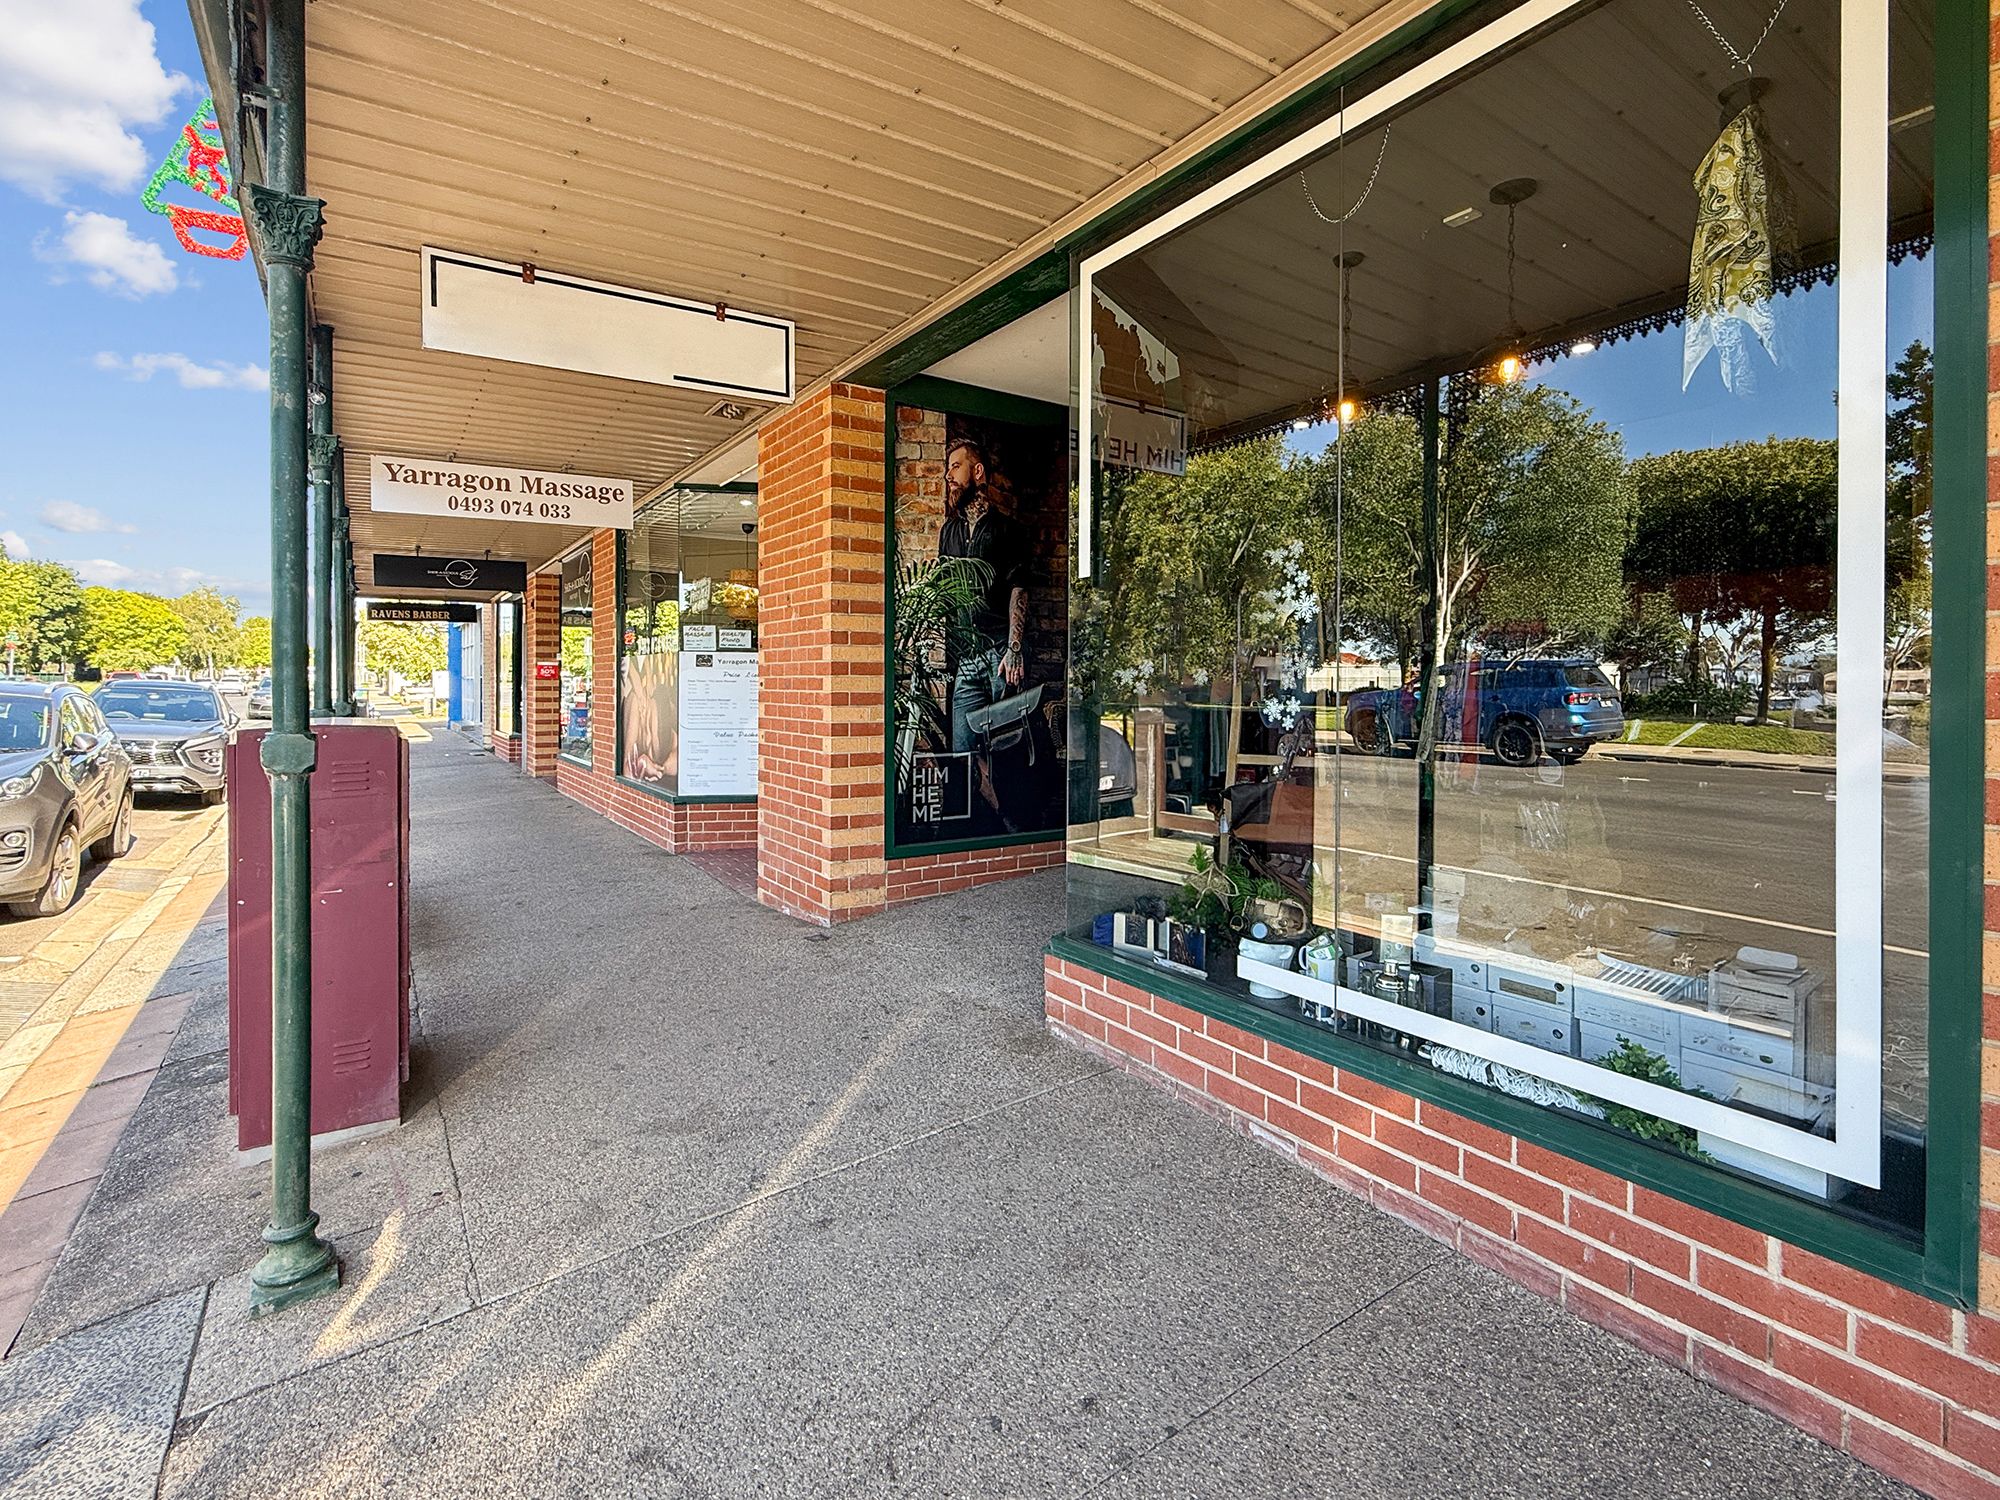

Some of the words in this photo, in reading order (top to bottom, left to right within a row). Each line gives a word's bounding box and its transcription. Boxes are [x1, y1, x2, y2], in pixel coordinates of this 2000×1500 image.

[382, 462, 512, 493] Yarragon
[520, 475, 625, 505] Massage
[448, 495, 494, 514] 0493
[500, 499, 533, 517] 074
[539, 502, 571, 519] 033
[371, 609, 411, 619] RAVENS
[412, 610, 450, 620] BARBER
[913, 766, 949, 785] HIM
[913, 785, 940, 804] HE
[913, 804, 941, 823] ME
